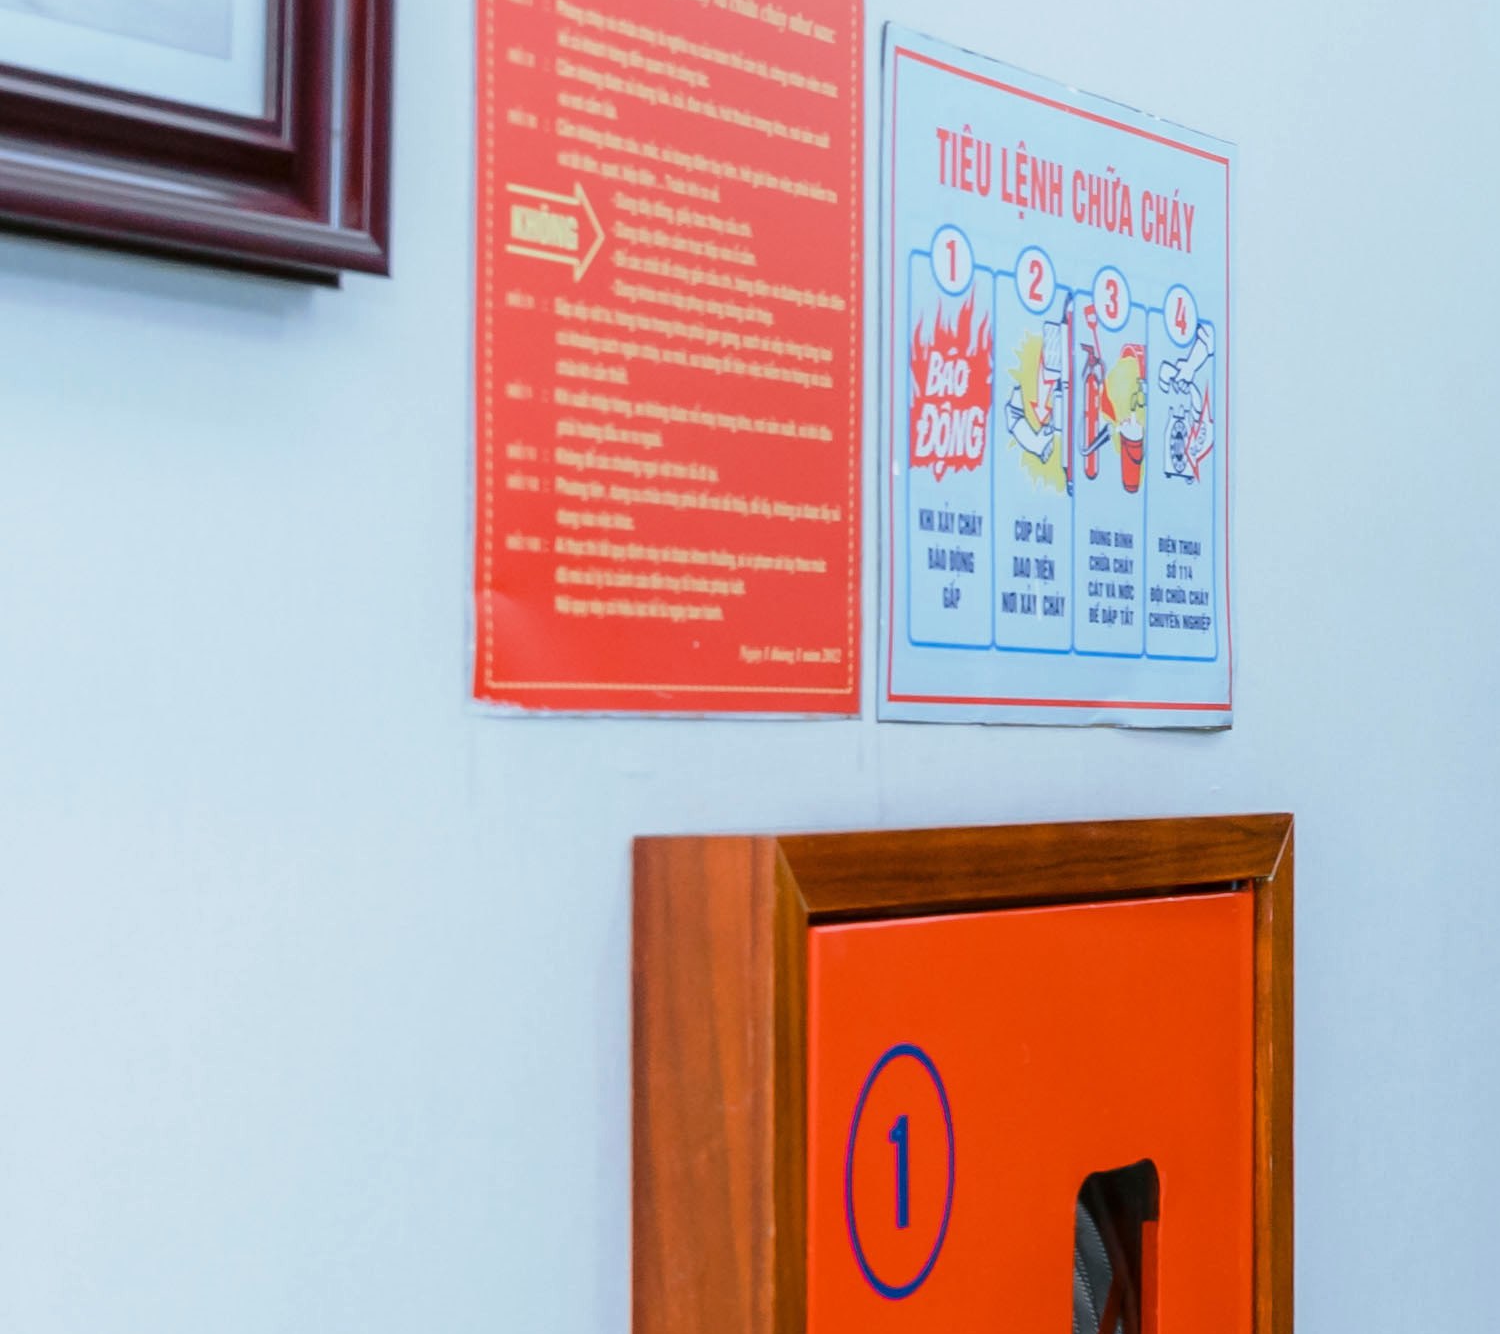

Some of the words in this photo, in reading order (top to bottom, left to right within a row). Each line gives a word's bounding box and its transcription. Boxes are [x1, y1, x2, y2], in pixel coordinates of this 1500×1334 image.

[936, 123, 992, 197] TIÊU
[1001, 140, 1064, 220] LỆNH
[1072, 165, 1133, 237] CHỮA
[1141, 188, 1195, 254] CHÁY
[946, 240, 957, 282] 1
[1028, 259, 1044, 302] 2
[1105, 278, 1119, 320] 3
[1175, 297, 1188, 336] 4
[925, 347, 971, 397] BÁO
[915, 401, 985, 474] ĐỘNG
[888, 1114, 910, 1229] 1
